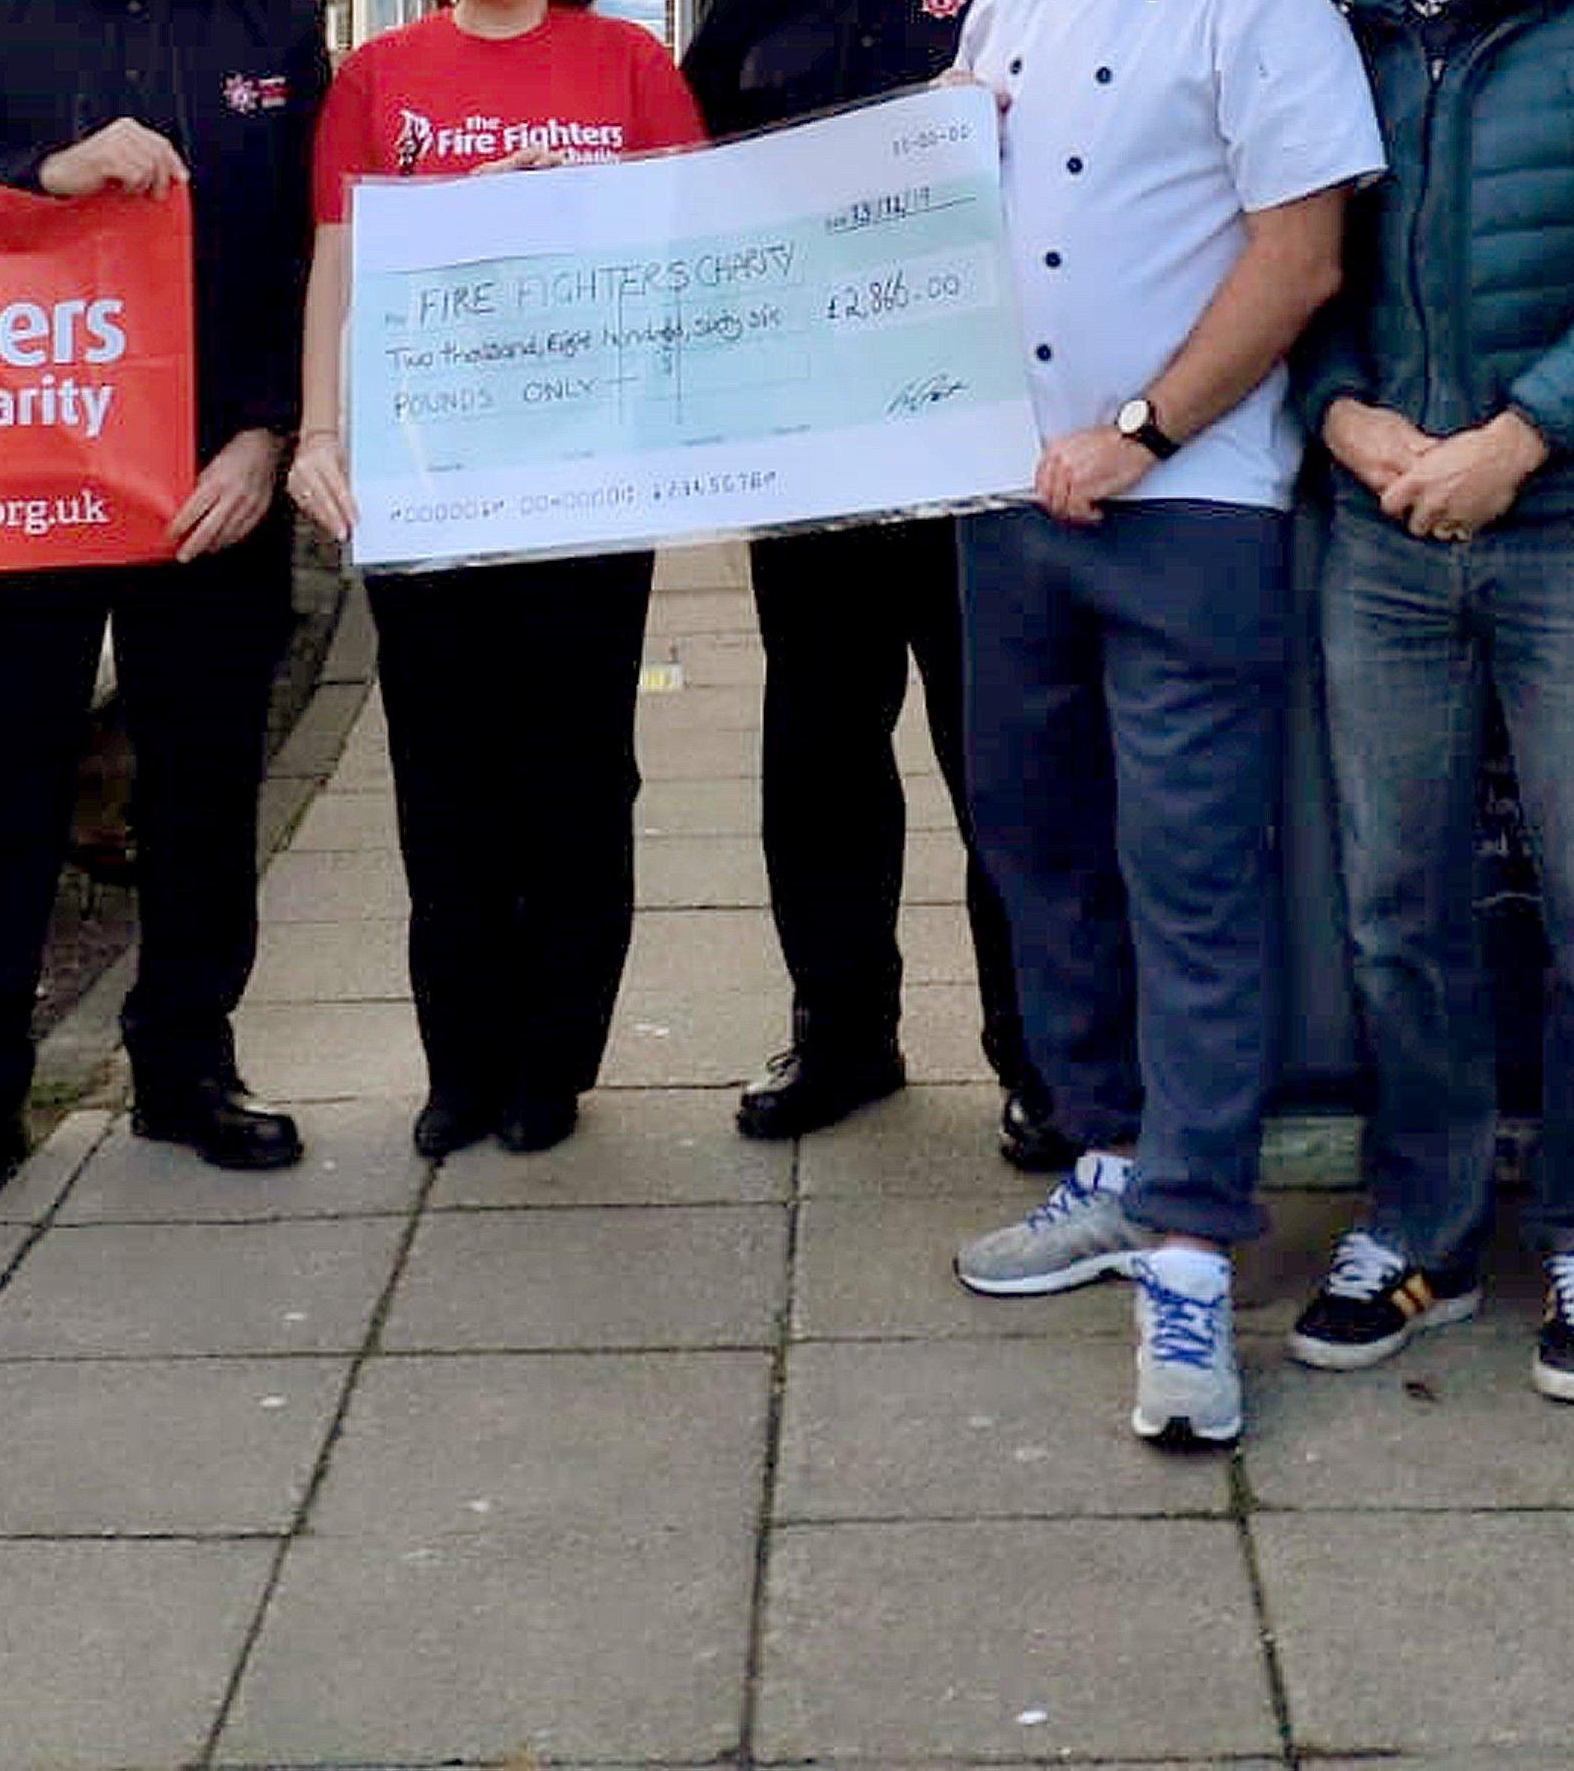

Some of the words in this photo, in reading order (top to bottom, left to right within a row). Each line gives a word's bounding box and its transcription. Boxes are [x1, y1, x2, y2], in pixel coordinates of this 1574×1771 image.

[437, 128, 497, 156] Fire
[504, 119, 623, 150] Fighters
[418, 280, 494, 325] FIRE
[394, 388, 494, 420] POUNDS
[524, 376, 596, 404] ONLY
